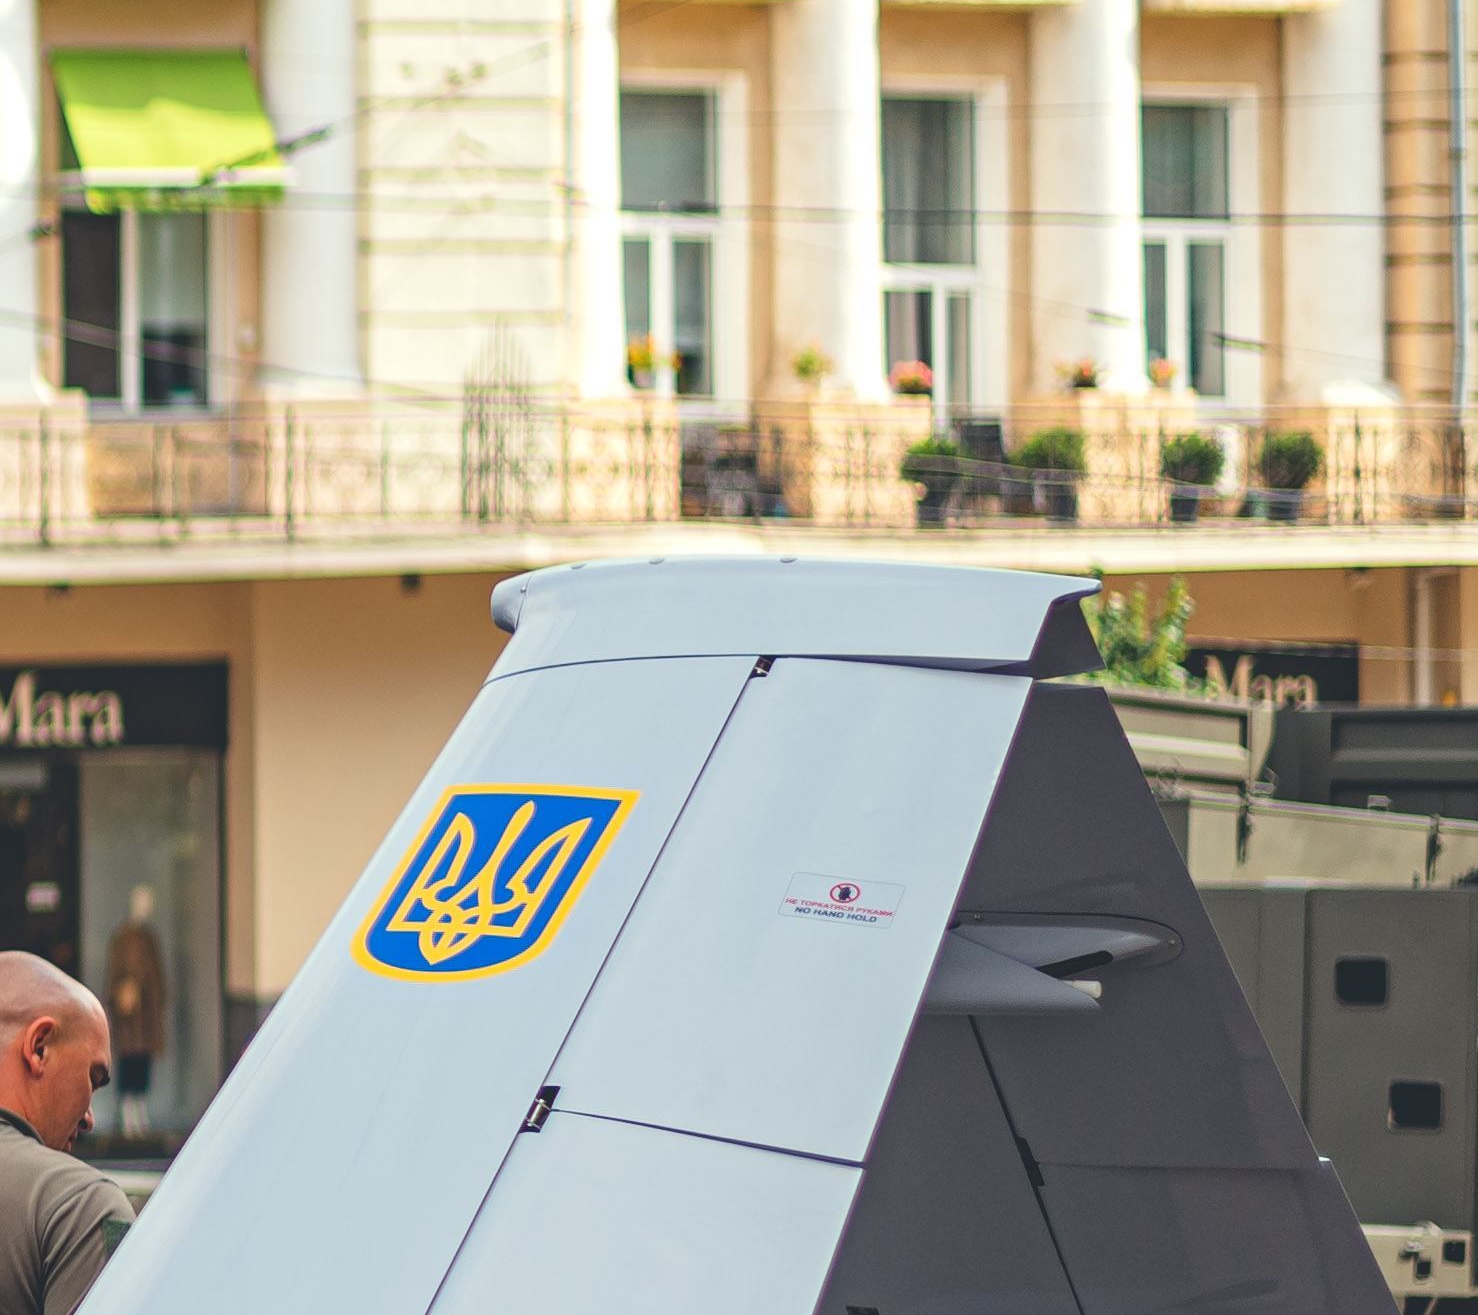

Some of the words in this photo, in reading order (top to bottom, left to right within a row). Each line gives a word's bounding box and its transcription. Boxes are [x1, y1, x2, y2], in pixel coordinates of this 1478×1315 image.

[784, 897, 798, 905] НЕ
[794, 906, 811, 914] NO
[813, 908, 844, 919] HAND
[847, 913, 878, 923] HOLD
